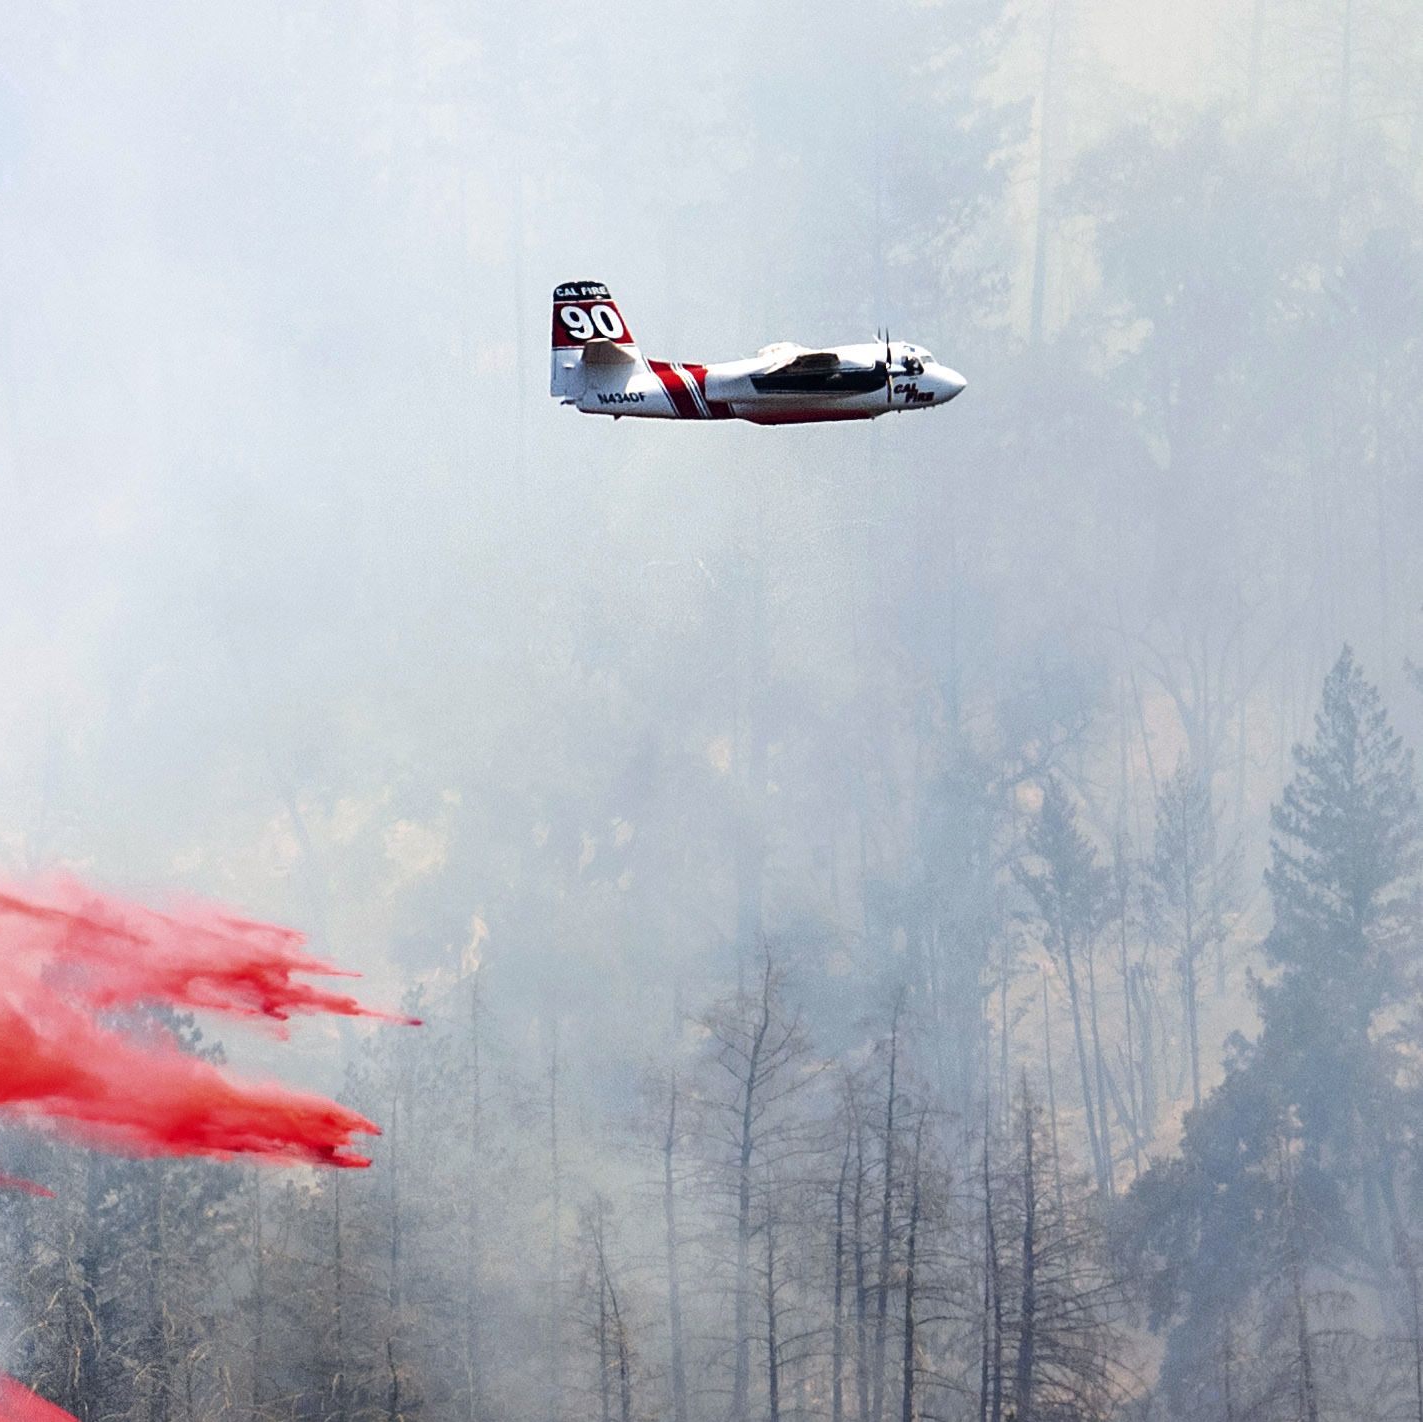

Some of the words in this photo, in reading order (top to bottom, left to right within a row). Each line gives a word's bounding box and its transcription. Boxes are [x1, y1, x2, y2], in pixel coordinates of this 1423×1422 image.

[556, 287, 579, 297] CAL
[582, 286, 608, 296] FIRE
[560, 304, 624, 340] 90
[597, 391, 646, 404] N434DF
